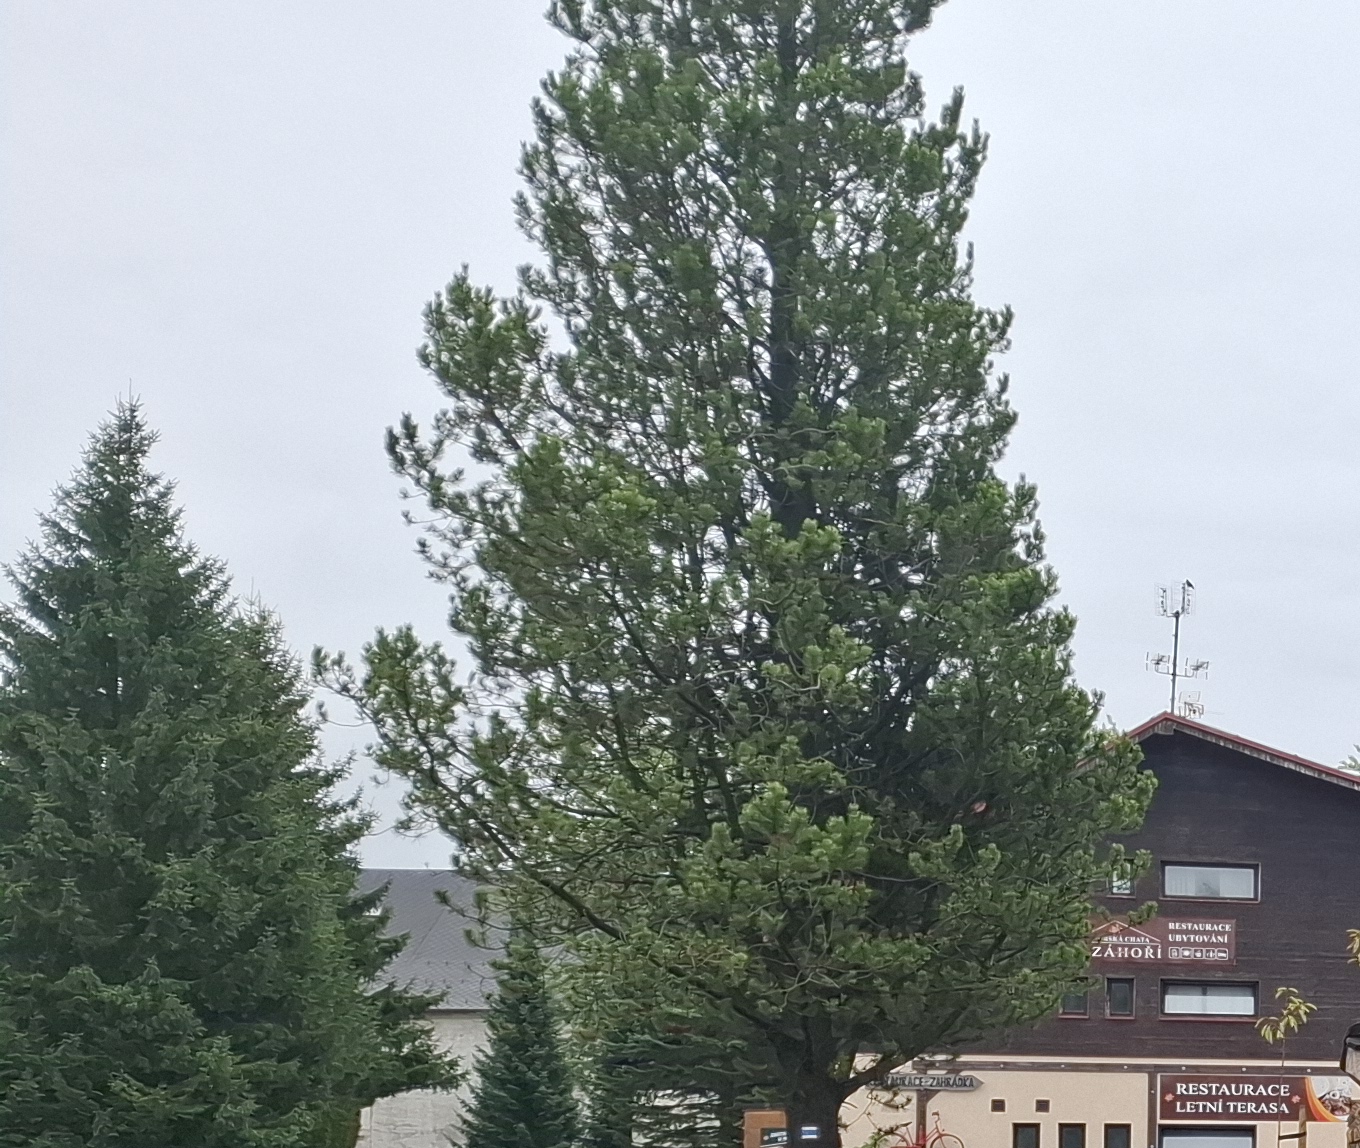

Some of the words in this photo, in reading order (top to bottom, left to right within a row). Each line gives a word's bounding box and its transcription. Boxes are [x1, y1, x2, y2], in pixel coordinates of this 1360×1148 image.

[1168, 922, 1232, 932] RESTAURACE
[1168, 933, 1228, 943] UBYTOVÁNÍ
[1091, 943, 1162, 959] ZÁHOŘÍ
[1176, 1083, 1290, 1097] RESTAURACE
[1175, 1099, 1223, 1114] LETNÍ
[1226, 1102, 1290, 1114] TERASA
